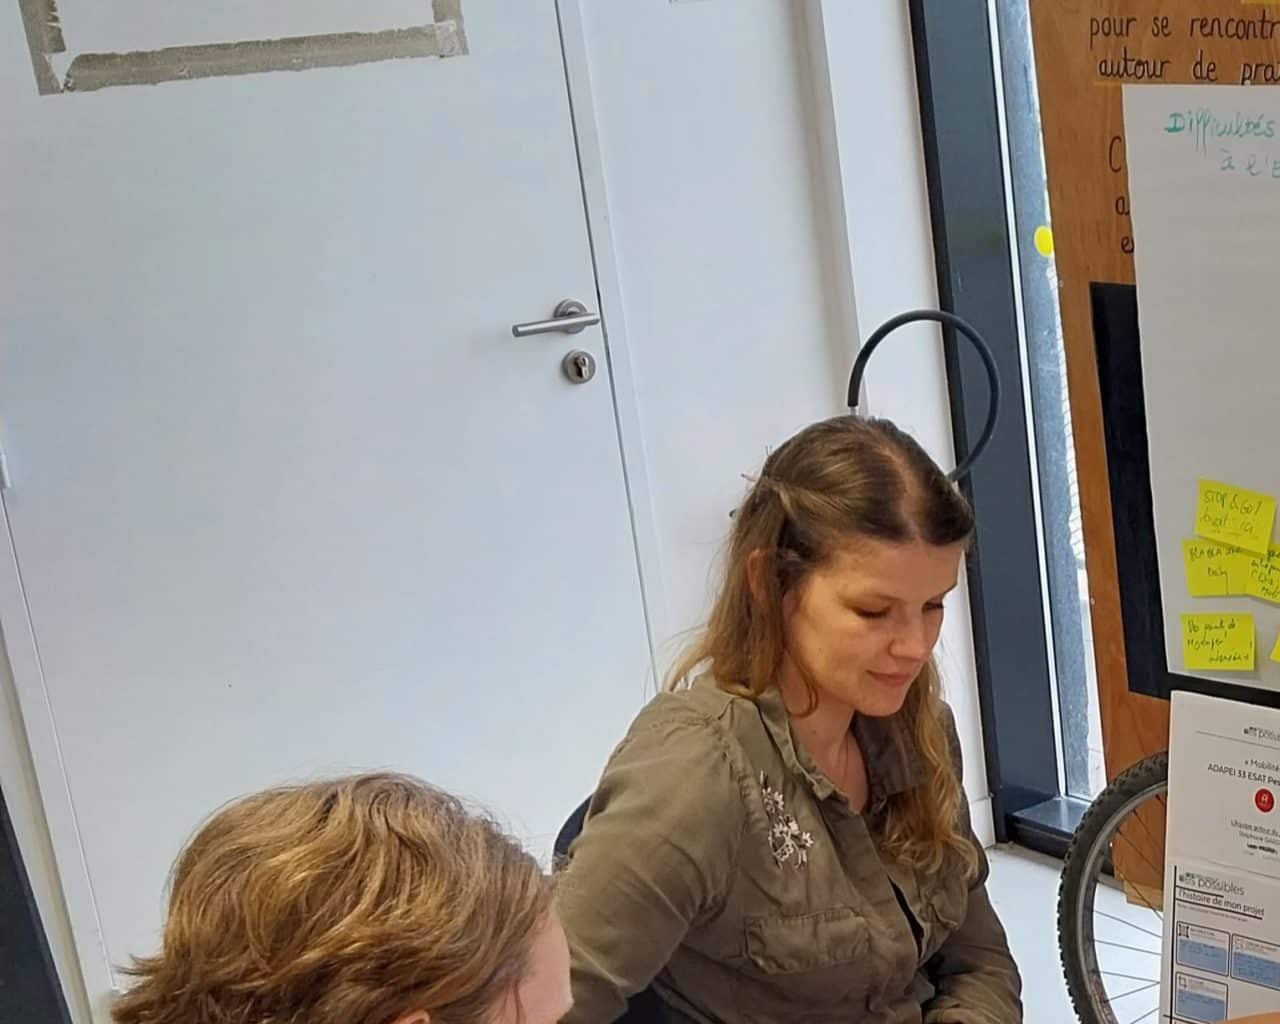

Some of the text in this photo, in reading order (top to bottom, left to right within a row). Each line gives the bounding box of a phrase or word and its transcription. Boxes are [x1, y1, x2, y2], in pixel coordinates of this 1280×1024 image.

[1090, 17, 1138, 50] pour
[1151, 18, 1172, 38] se
[1099, 47, 1166, 78] autour
[1193, 48, 1218, 82] de
[1164, 106, 1276, 155] Difficultés
[1208, 763, 1236, 776] ADAPEI
[1237, 769, 1246, 779] 33
[1248, 771, 1267, 784] ESAT
[1212, 896, 1222, 906] de
[1223, 900, 1242, 911] mon
[1243, 904, 1264, 916] projet
